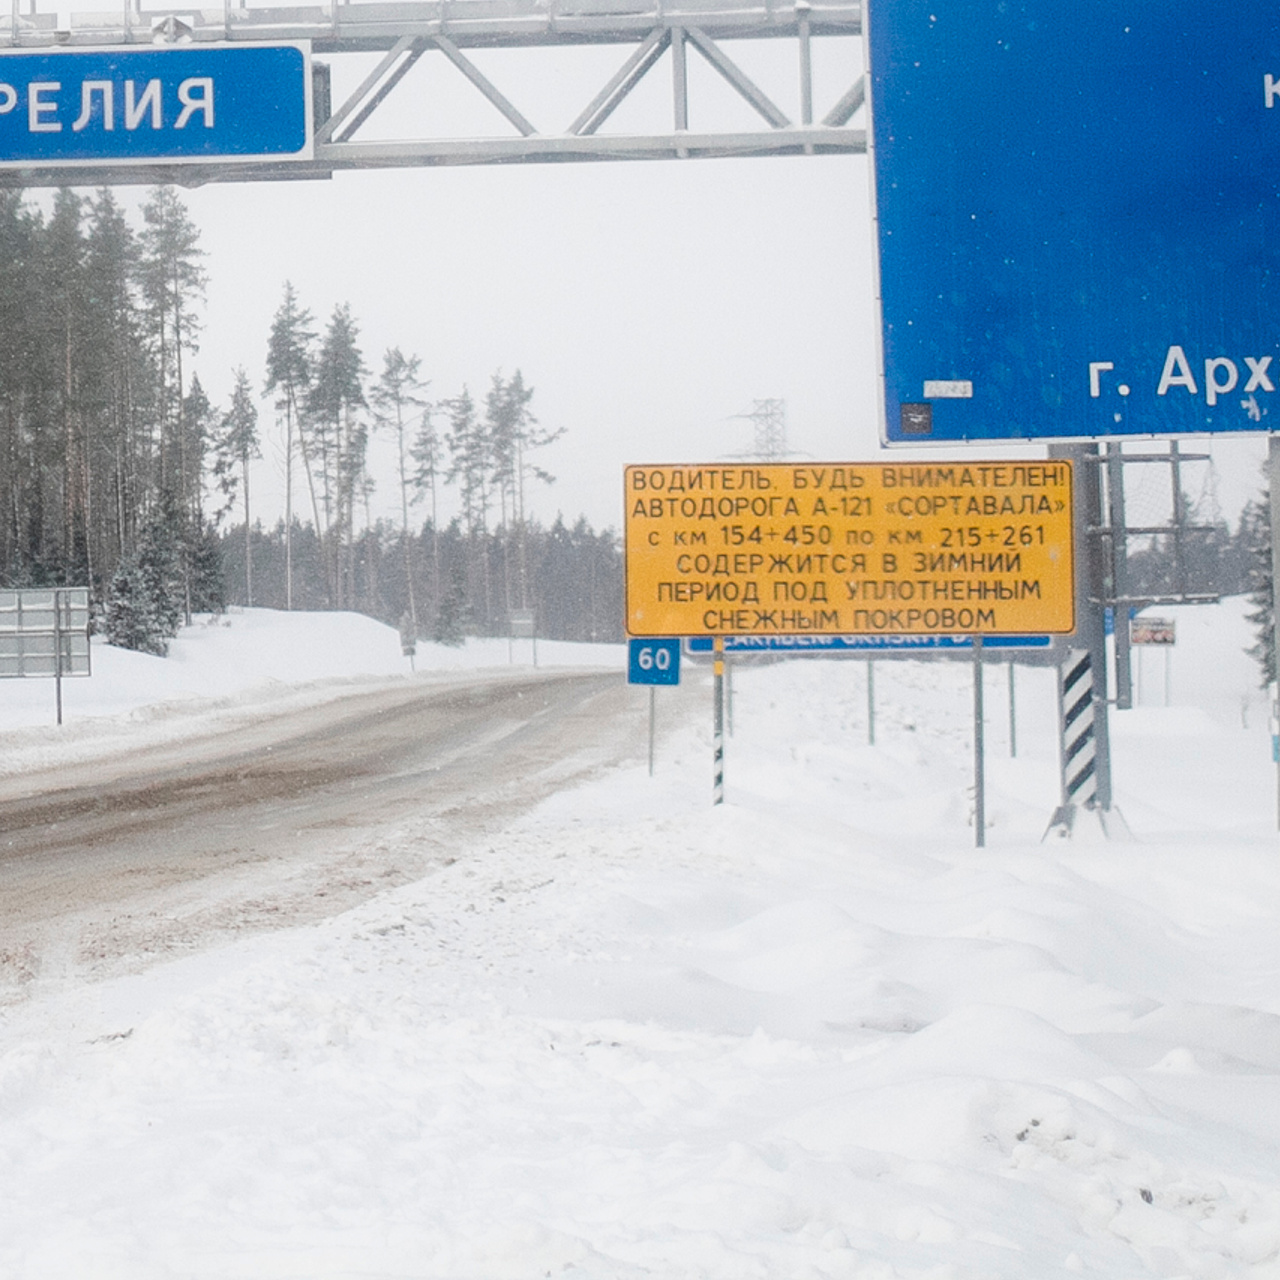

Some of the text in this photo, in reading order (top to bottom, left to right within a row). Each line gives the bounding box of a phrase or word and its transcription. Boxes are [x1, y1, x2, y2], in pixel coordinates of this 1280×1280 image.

[1089, 345, 1276, 406] г. Арх
[793, 468, 865, 491] БУДЬ
[881, 466, 1065, 488] ВНИМАТЕЛЕН!
[632, 494, 1066, 520] АВТОДОРОГА А-121 «СОРТАВАЛА»
[720, 524, 832, 546] 154+450
[939, 525, 1045, 548] 215+261
[677, 548, 1022, 577] СОДЕРЖИТСЯ В ЗИМНИЙ
[657, 579, 1042, 605] ПЕРИОД ПОД УПЛОТНЕННЫМ
[703, 608, 997, 630] СНЕЖНЫМ ПОКРОВОМ
[638, 647, 671, 671] 60
